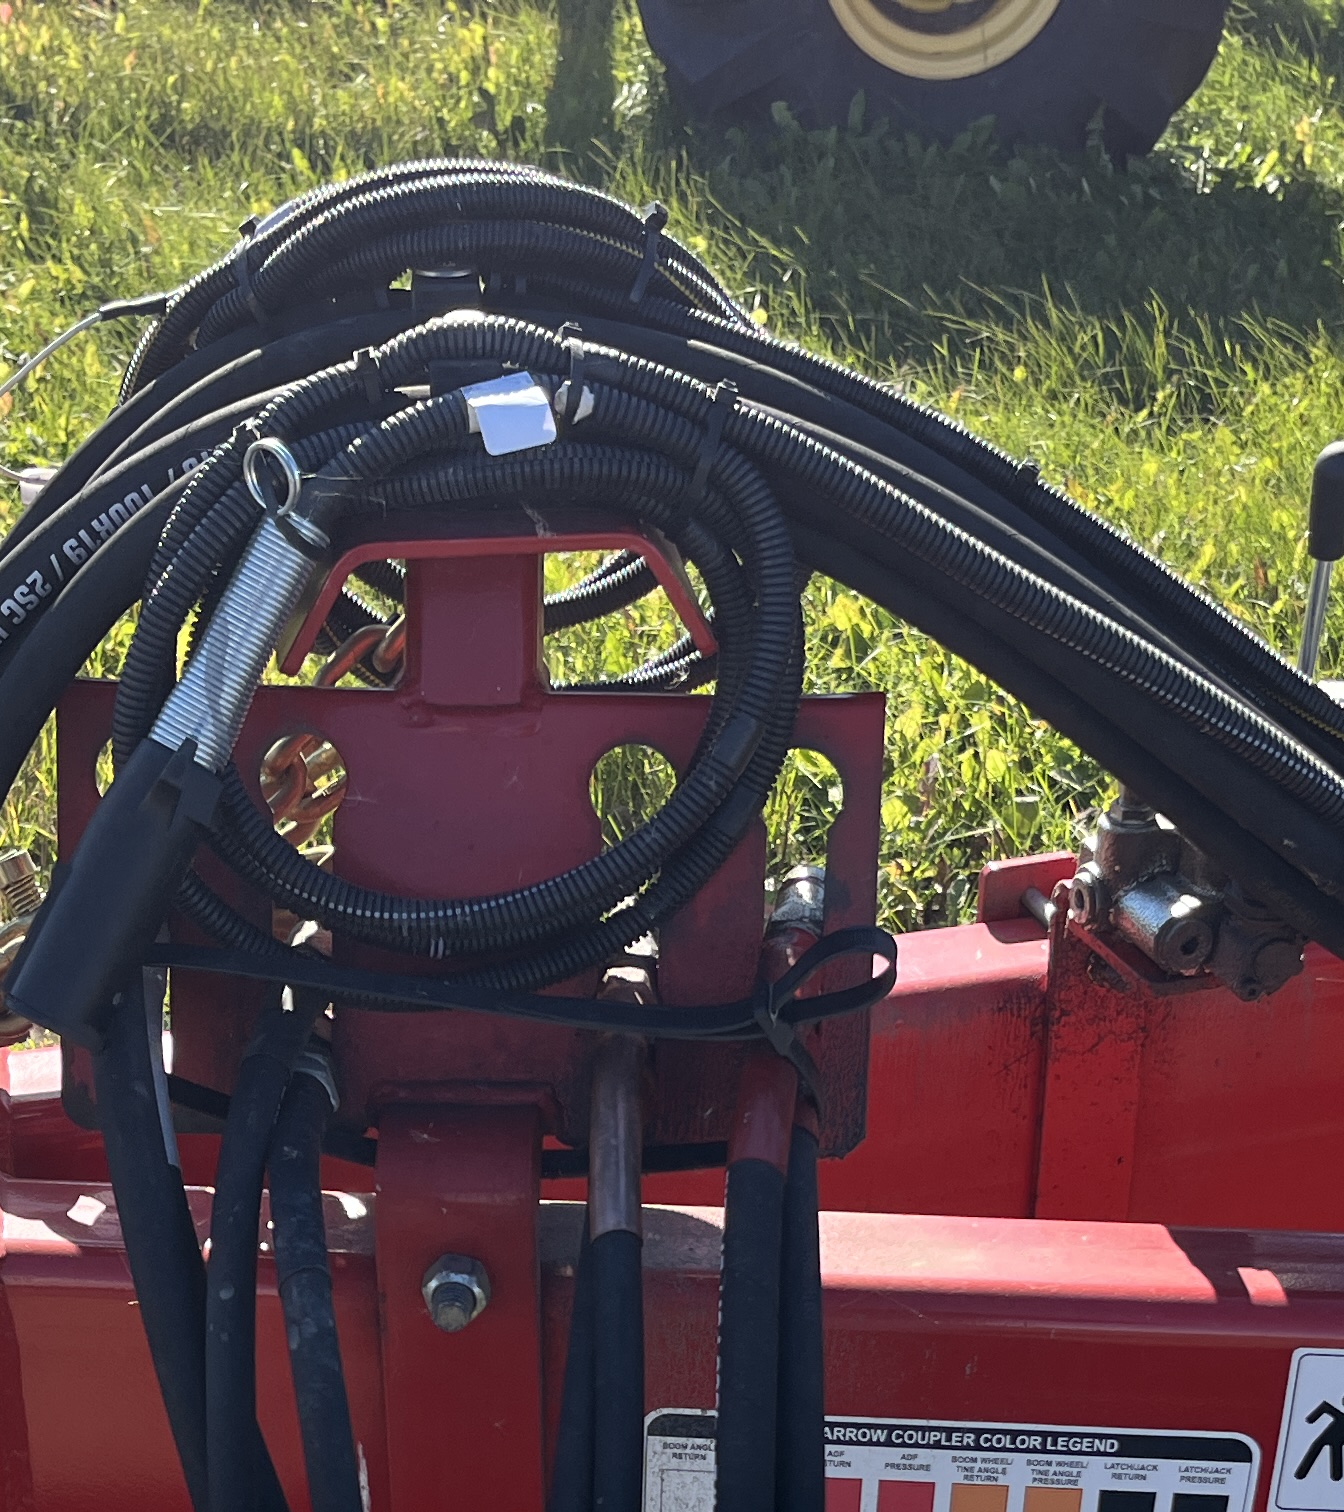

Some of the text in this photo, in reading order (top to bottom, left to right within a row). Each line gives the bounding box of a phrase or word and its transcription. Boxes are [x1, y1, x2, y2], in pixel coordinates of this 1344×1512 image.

[0, 569, 53, 625] 2SC
[823, 1426, 1118, 1452] ARROW COUPLER COLOR LEGEND
[690, 1443, 715, 1452] ANGL
[671, 1452, 707, 1461] RETURN
[900, 1453, 918, 1461] ADF
[952, 1455, 1013, 1465] BOOM WHEEL/
[884, 1462, 931, 1471] PRESSURE
[1026, 1458, 1088, 1468] BOOM WHEEL/
[955, 1465, 1007, 1475] TINE ANGLE
[1030, 1468, 1082, 1478] TINE ANGLE
[962, 1474, 998, 1482] RETURN
[1032, 1477, 1079, 1485] PRESSURE
[1111, 1472, 1146, 1481] RETURN
[1179, 1475, 1226, 1484] PRESSURE
